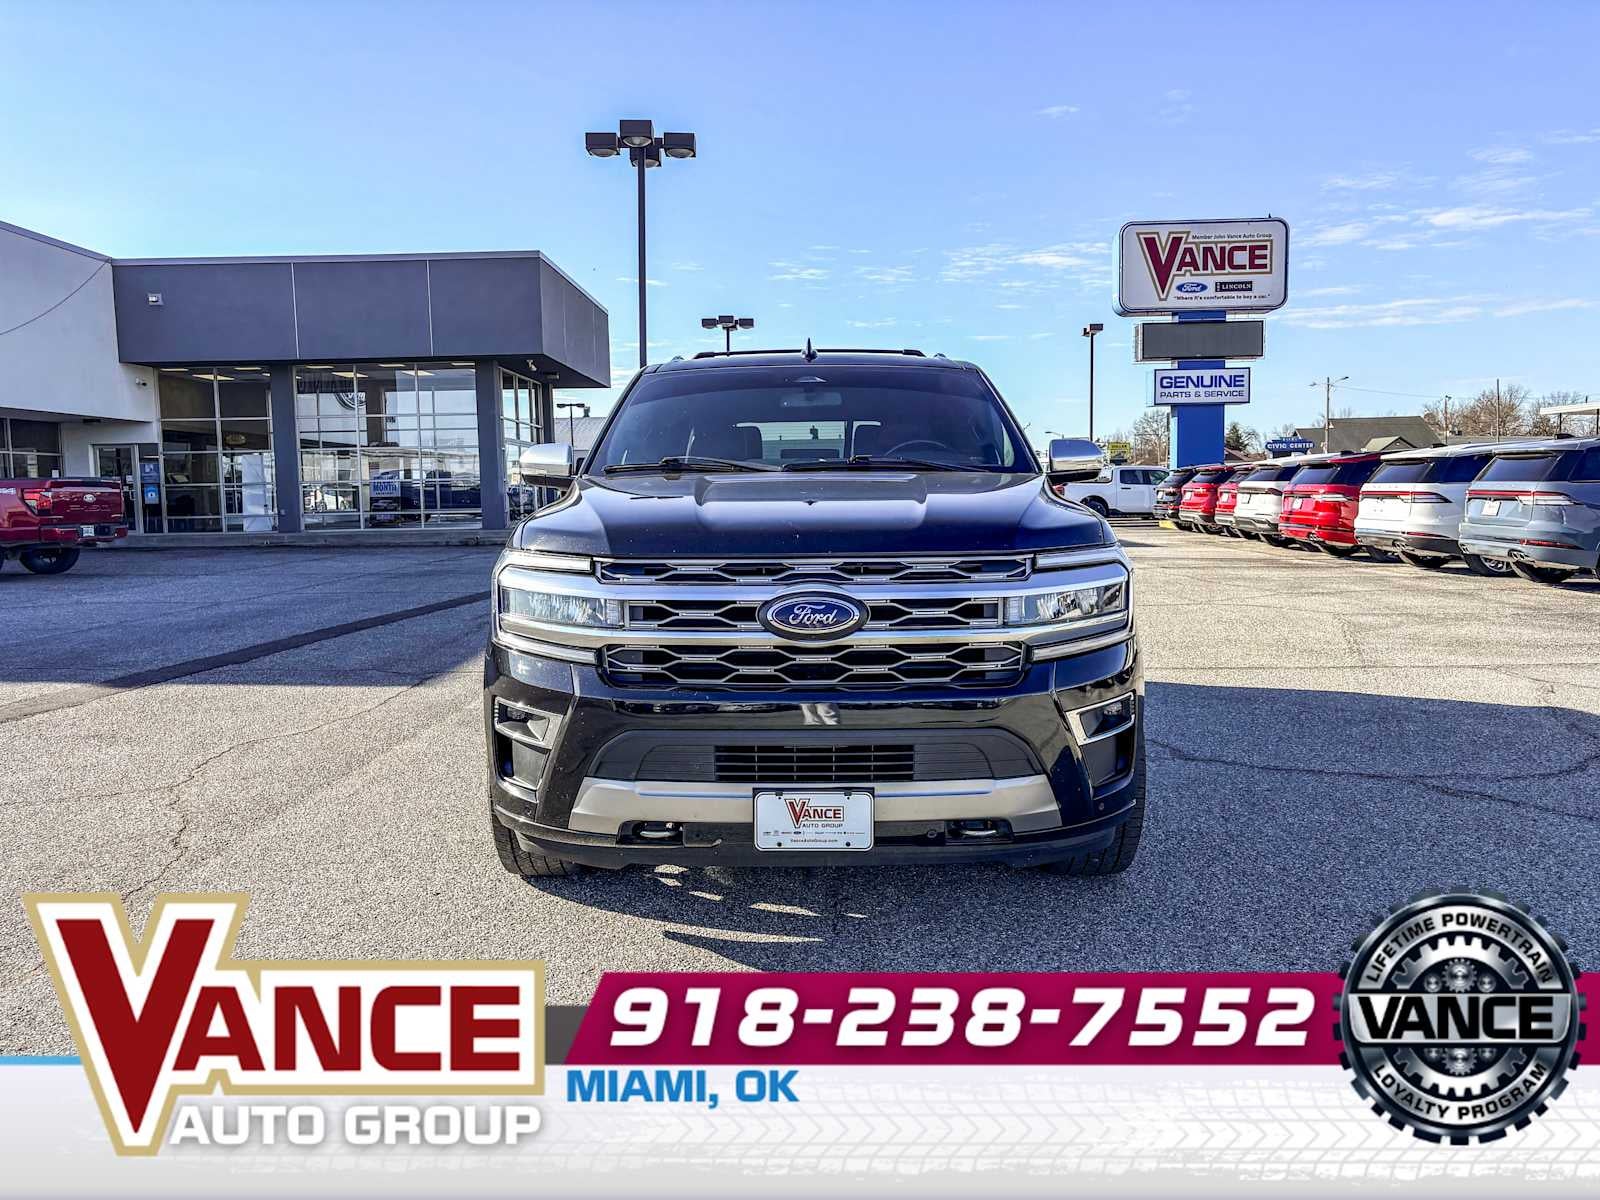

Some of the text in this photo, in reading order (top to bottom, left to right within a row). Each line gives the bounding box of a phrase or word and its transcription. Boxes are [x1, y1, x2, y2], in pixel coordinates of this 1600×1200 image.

[1143, 236, 1268, 295] VANCE
[1181, 282, 1202, 292] Ford
[1159, 374, 1245, 389] GENUINE
[1160, 389, 1245, 398] PARTS & SERVICE
[788, 604, 838, 625] Ford
[788, 801, 842, 825] VANCE
